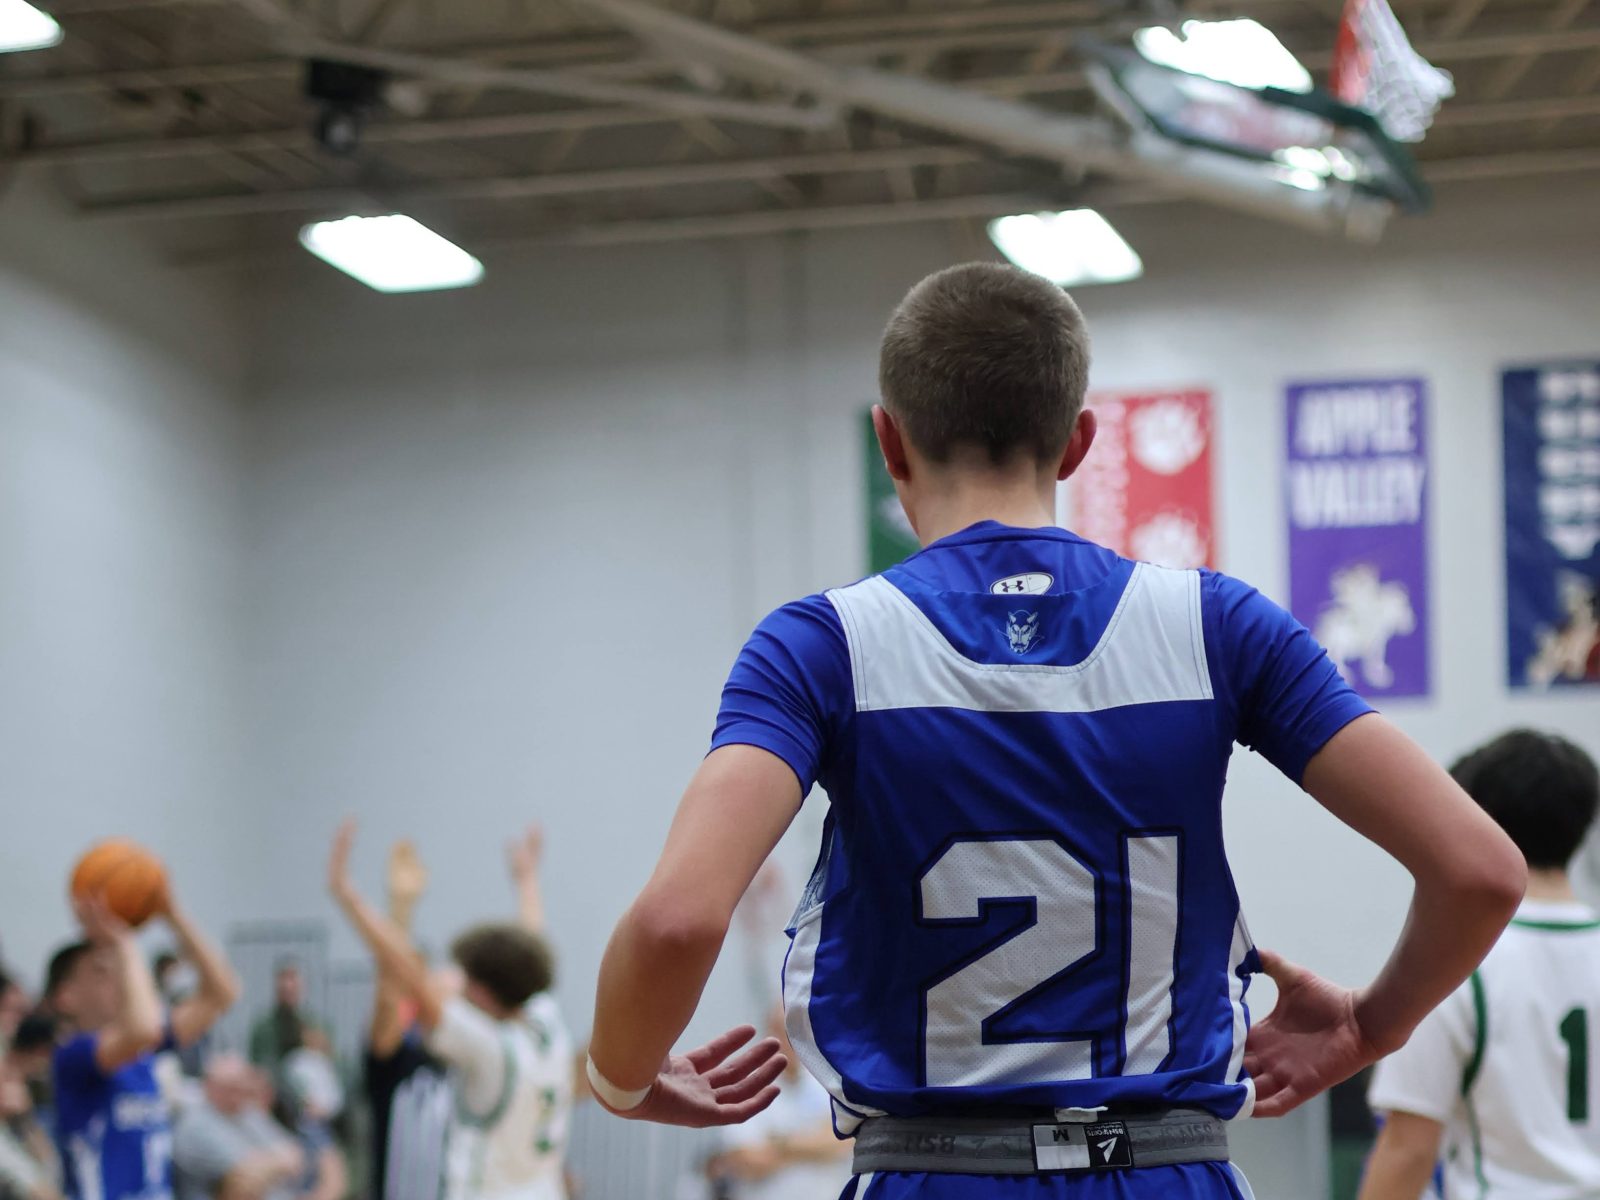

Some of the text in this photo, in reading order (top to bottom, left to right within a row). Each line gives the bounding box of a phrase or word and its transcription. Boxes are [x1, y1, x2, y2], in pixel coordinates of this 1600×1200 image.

[1298, 387, 1417, 455] APPLE
[1291, 461, 1426, 528] VALLEY
[917, 832, 1181, 1088] 21
[1559, 1007, 1588, 1122] 1
[1052, 1129, 1070, 1143] M
